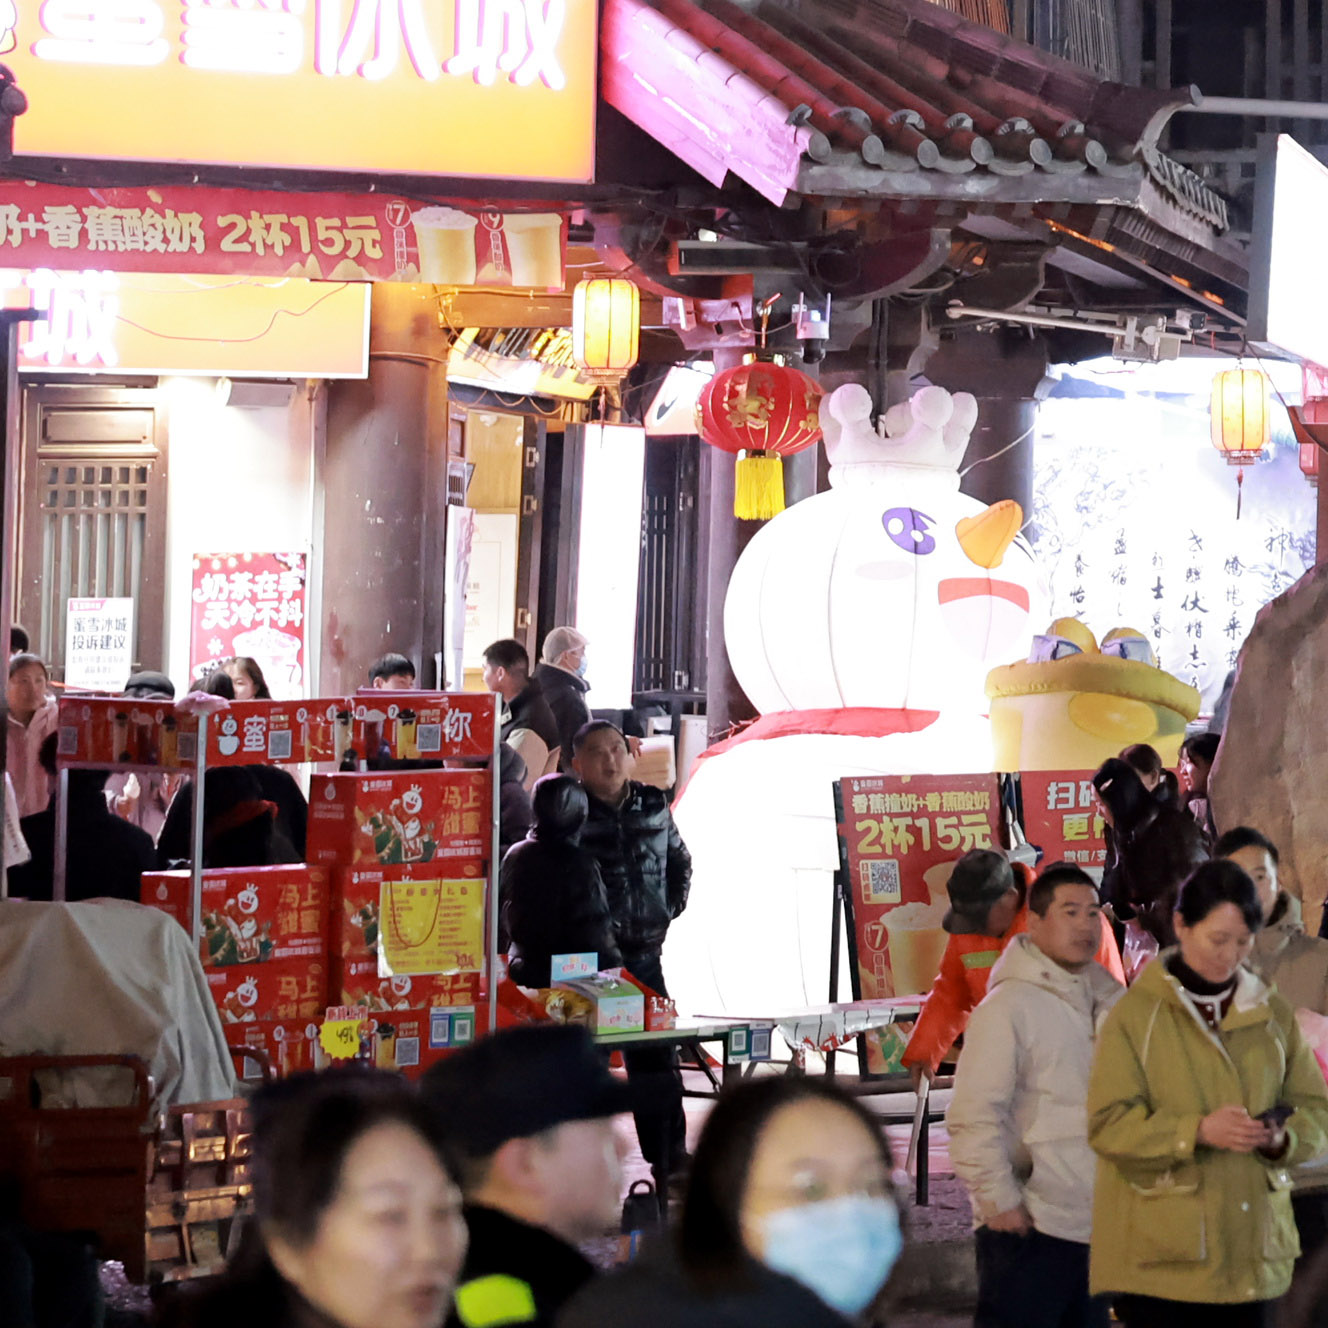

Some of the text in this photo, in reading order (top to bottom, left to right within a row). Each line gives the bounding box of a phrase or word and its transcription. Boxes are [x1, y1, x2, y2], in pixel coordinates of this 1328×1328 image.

[218, 211, 384, 259] 2杯15元
[193, 571, 302, 603] 奶茶在手
[73, 616, 128, 634] 蜜雪冰城
[202, 598, 304, 629] 天冷不抖
[72, 634, 126, 651] 投诉建议
[855, 812, 992, 855] 2杯15元
